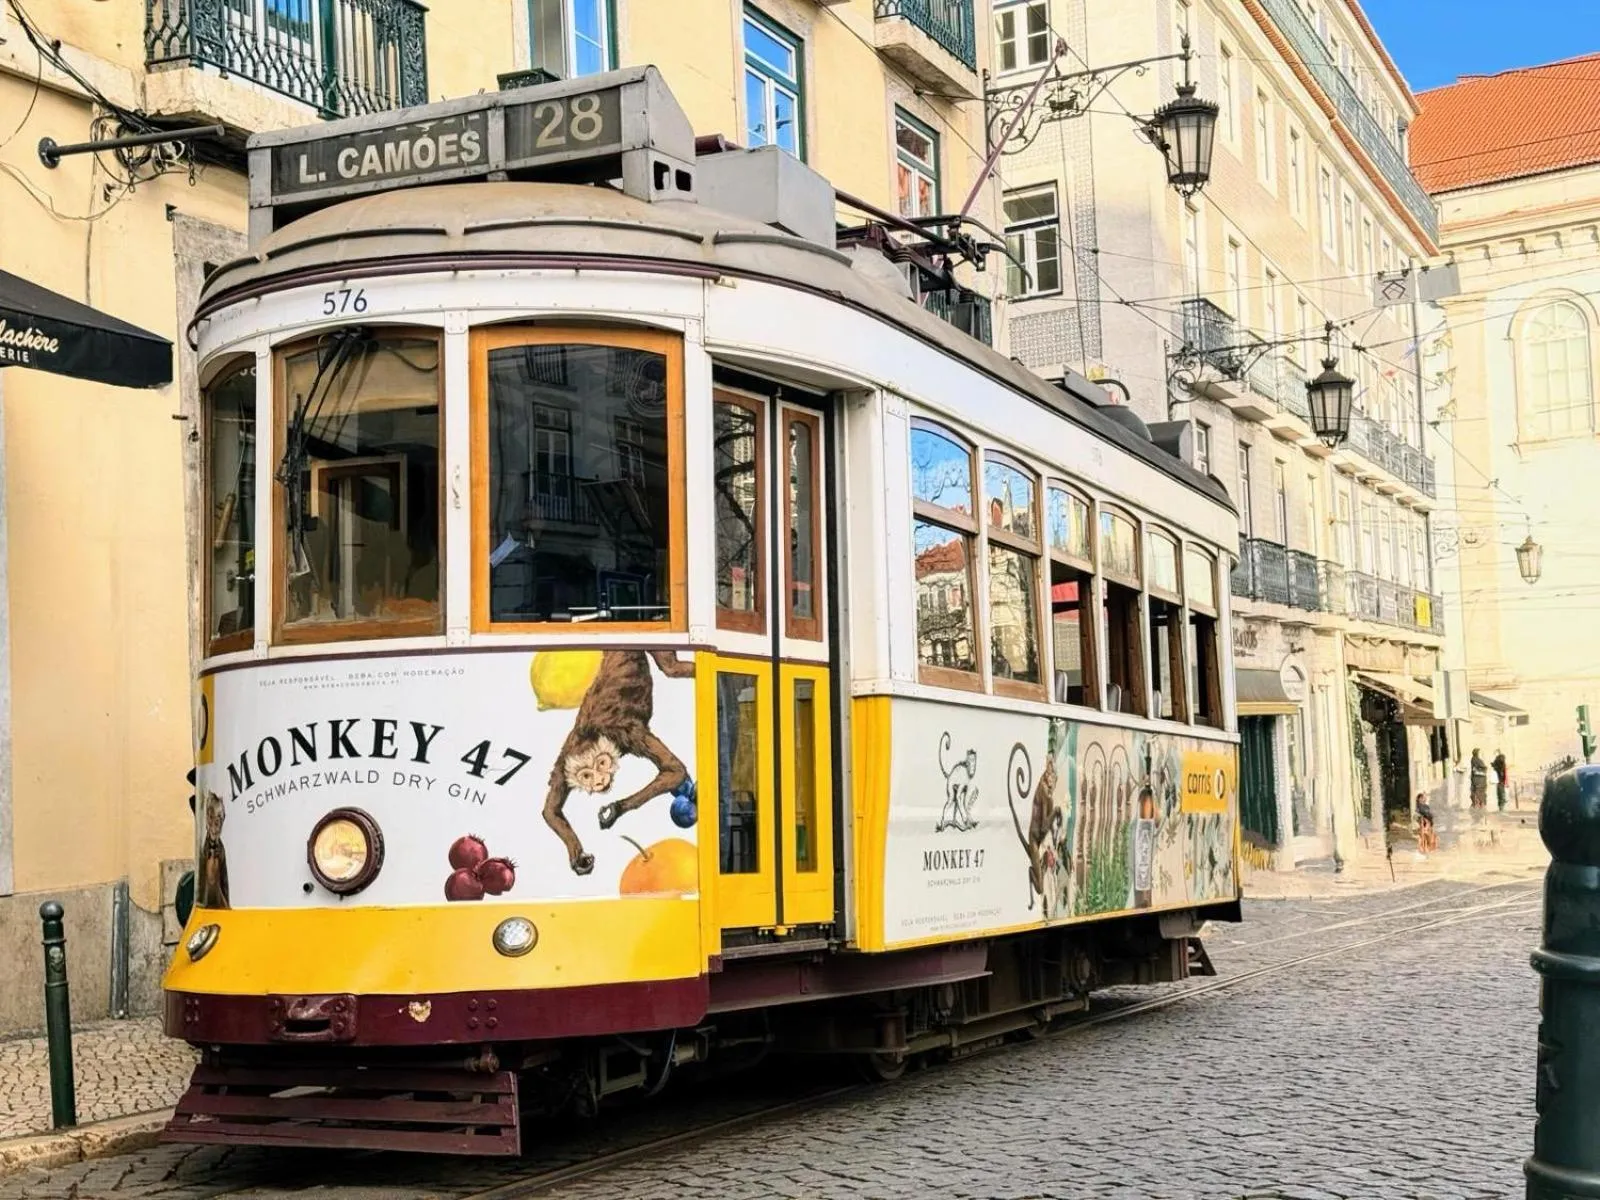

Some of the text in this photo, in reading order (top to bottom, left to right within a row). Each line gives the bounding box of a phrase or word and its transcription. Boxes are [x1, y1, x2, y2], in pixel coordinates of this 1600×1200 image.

[533, 94, 604, 149] 28
[300, 154, 327, 183] L.
[323, 288, 368, 316] 576
[226, 718, 532, 802] MONKEY 47
[246, 769, 487, 814] SCHWARZWALD DRY GIN
[1187, 765, 1211, 794] carris
[923, 849, 984, 871] MONKEY 47
